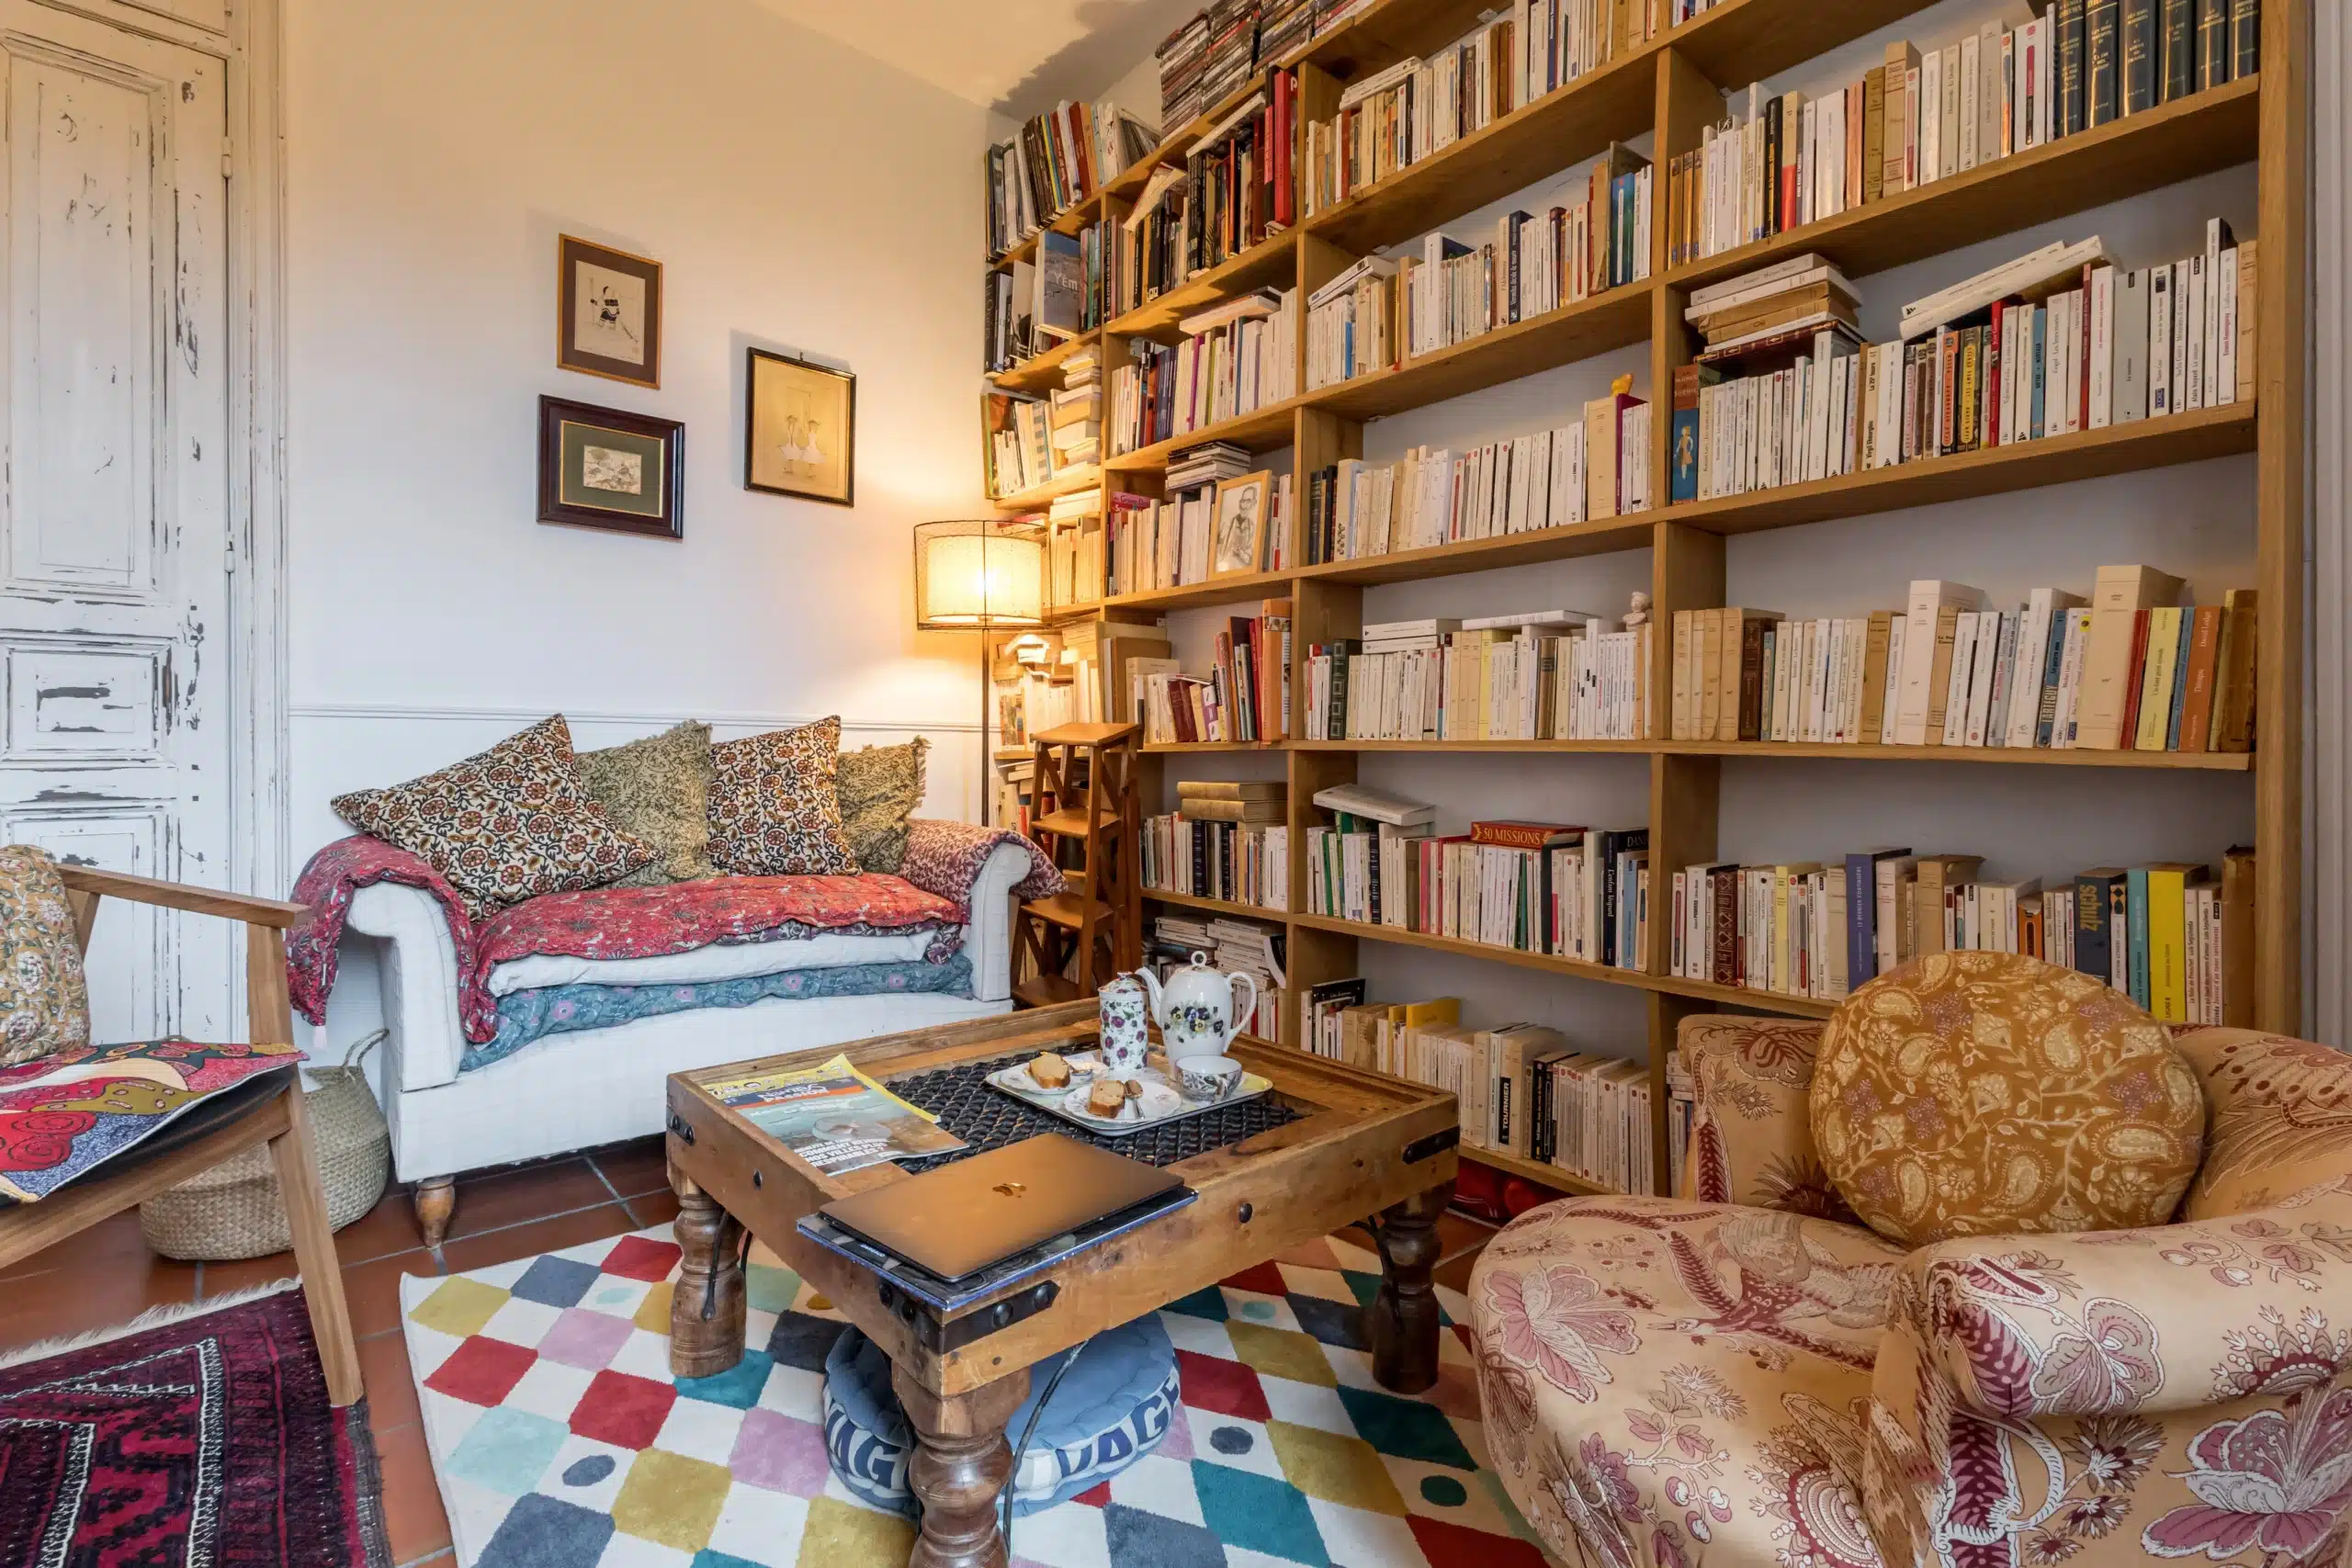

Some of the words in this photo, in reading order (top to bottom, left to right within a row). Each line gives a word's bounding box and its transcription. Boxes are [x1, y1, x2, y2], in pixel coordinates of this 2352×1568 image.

[1865, 445, 1873, 459] Virgil
[2199, 611, 2212, 630] Lodge
[2196, 630, 2210, 647] David
[1482, 827, 1494, 840] 50
[1494, 828, 1541, 845] MISSIONS
[1607, 869, 1615, 893] L'enfant
[1501, 1082, 1510, 1130] TOURNIER
[799, 1143, 851, 1158] COMMENT
[805, 1152, 826, 1164] NOS
[825, 1146, 864, 1160] VILLES
[810, 1149, 877, 1168] RESPIRABLES
